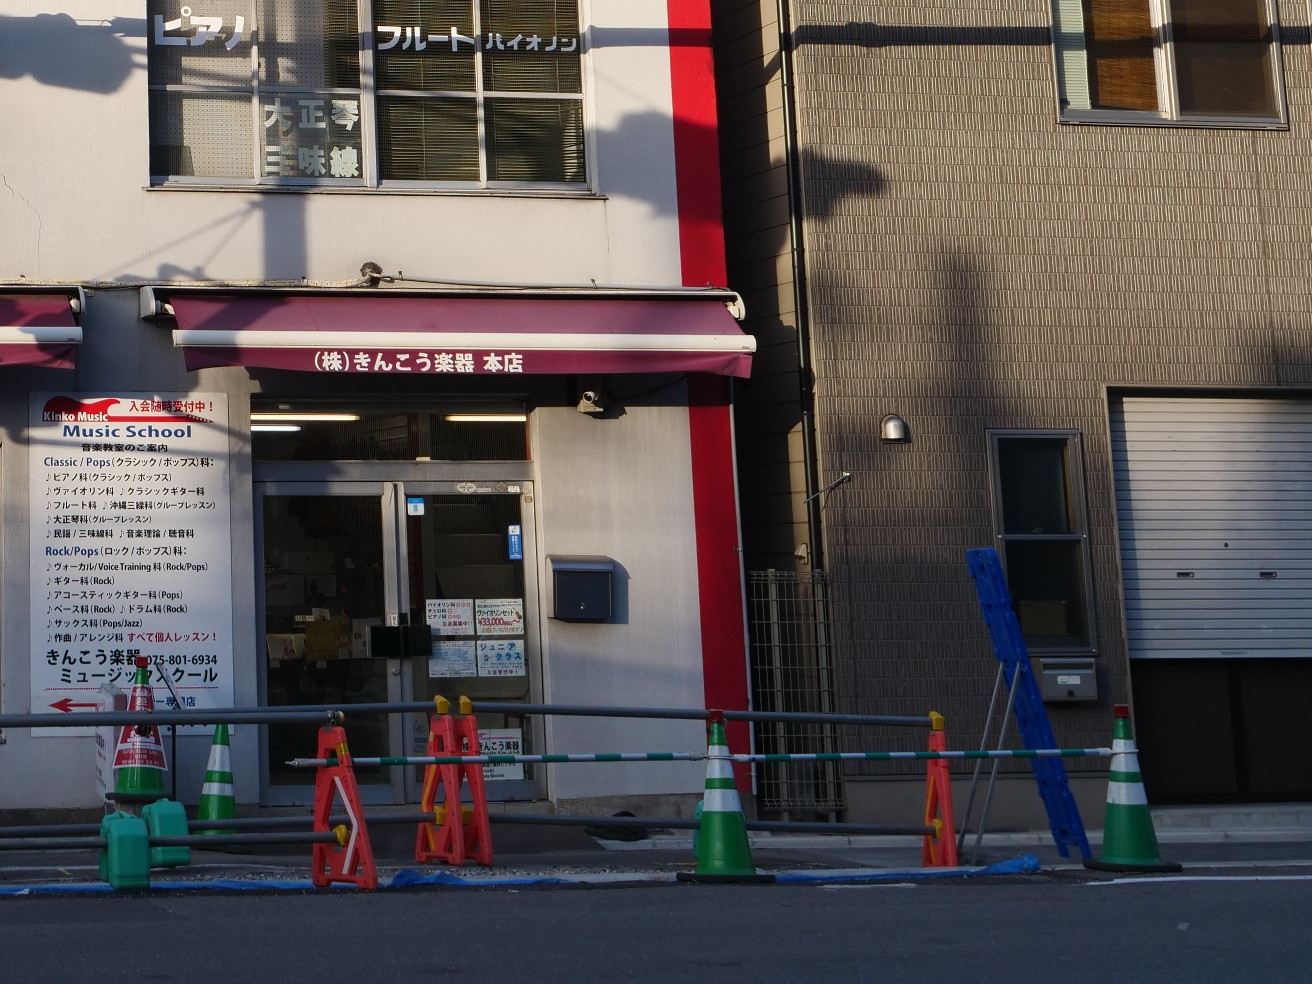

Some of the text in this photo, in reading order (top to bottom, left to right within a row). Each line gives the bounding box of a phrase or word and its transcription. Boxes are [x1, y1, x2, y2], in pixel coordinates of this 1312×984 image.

[153, 6, 245, 50] ピアノ
[377, 25, 475, 52] フルート
[264, 97, 359, 131] 大正琴
[264, 145, 359, 178] 三味線
[483, 352, 524, 373] 本店
[43, 411, 109, 422] Kinko Music
[63, 424, 192, 439] Music School
[80, 442, 169, 453] 音楽教室のご案内
[43, 457, 78, 467] Classic
[45, 546, 99, 558] Rock/Pops
[120, 562, 152, 573] Training
[46, 648, 141, 666] きんこう楽器
